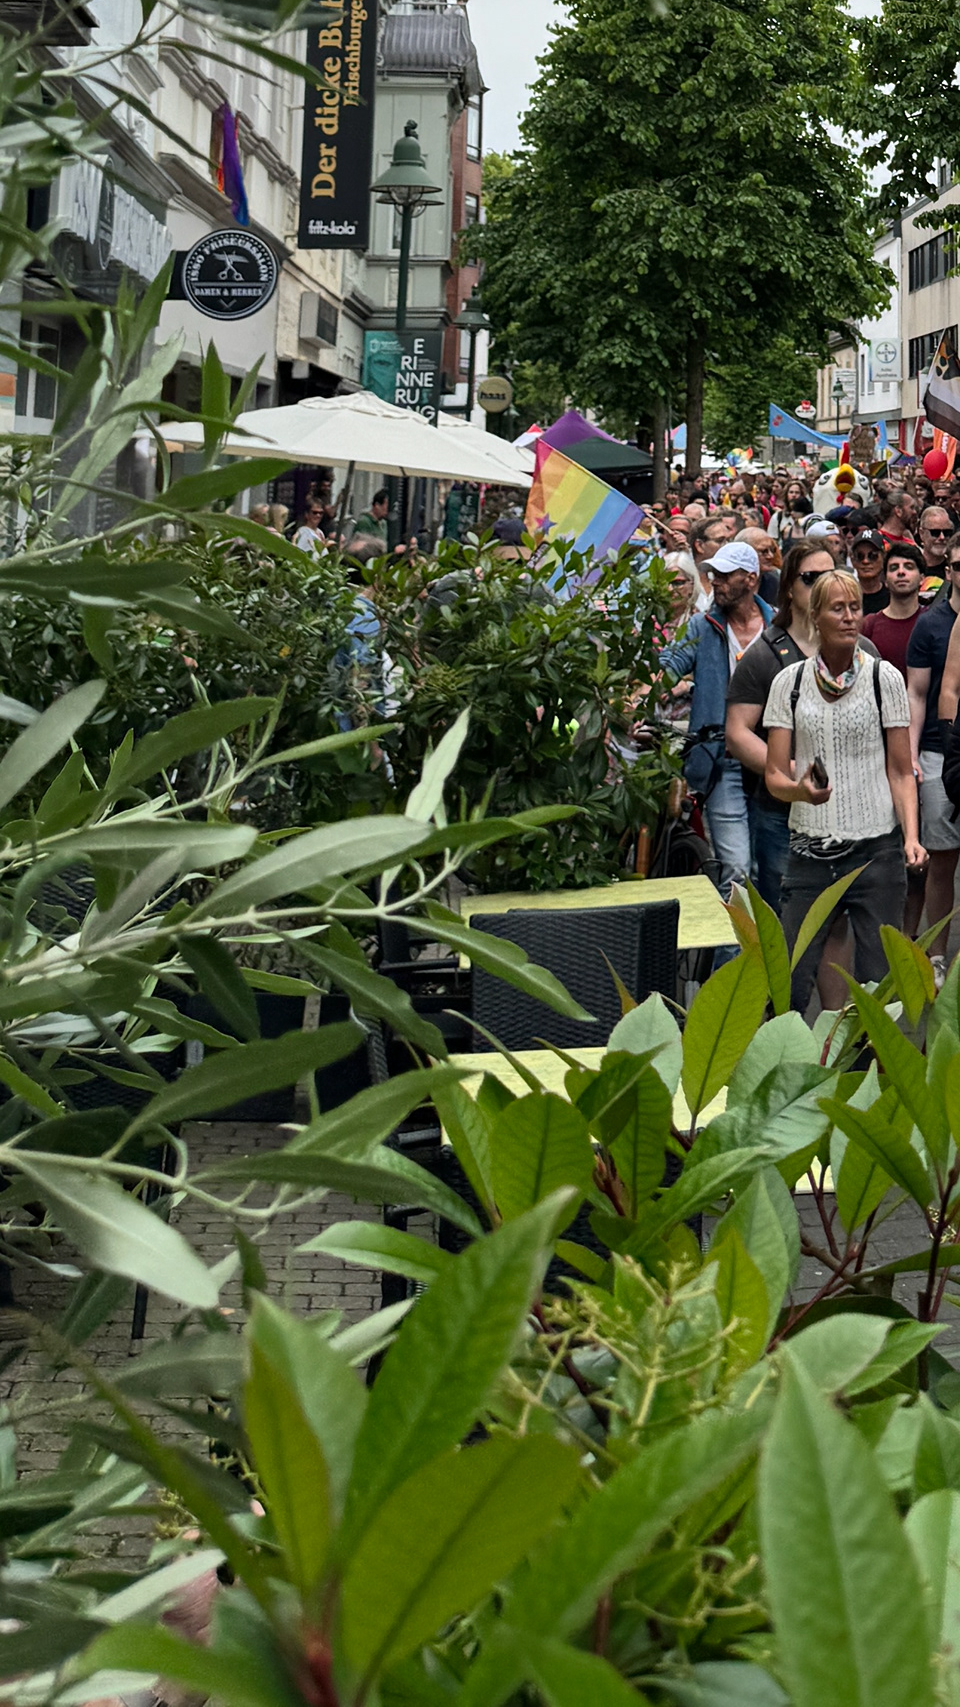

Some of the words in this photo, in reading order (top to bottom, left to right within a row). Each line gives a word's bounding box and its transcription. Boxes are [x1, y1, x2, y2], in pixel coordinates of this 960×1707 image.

[314, 57, 342, 136] dicke
[311, 143, 337, 199] Der
[395, 372, 434, 387] NNE
[395, 388, 419, 404] RU
